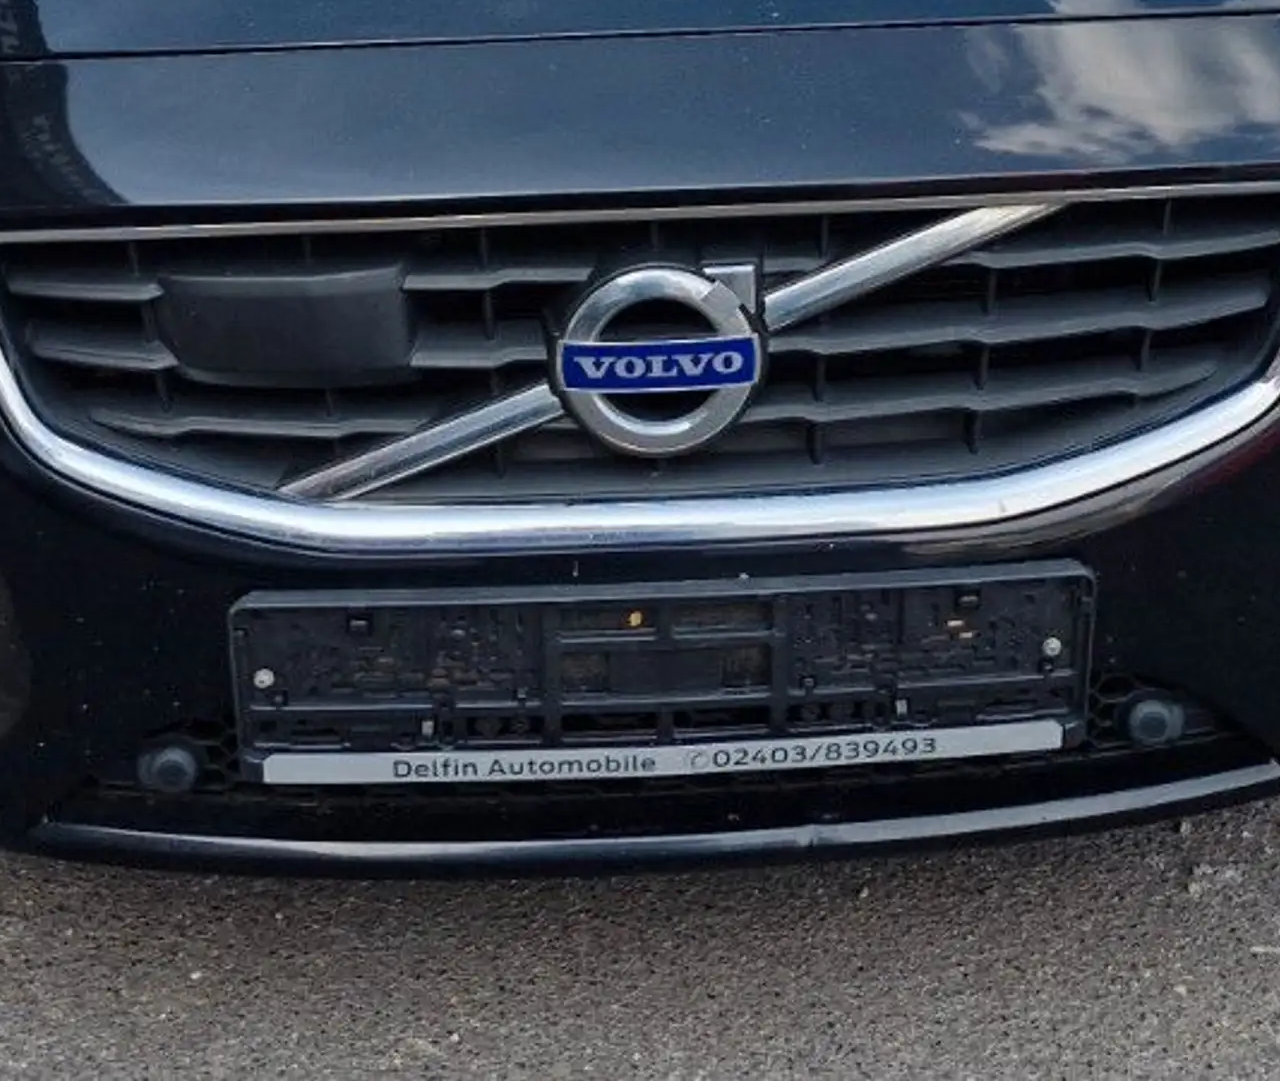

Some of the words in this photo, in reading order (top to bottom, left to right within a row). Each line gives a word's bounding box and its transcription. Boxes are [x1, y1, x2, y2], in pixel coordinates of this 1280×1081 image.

[573, 350, 744, 380] VOLVO
[392, 757, 479, 779] Delfin
[487, 753, 656, 777] Automobile
[712, 736, 938, 769] 02403/839493
